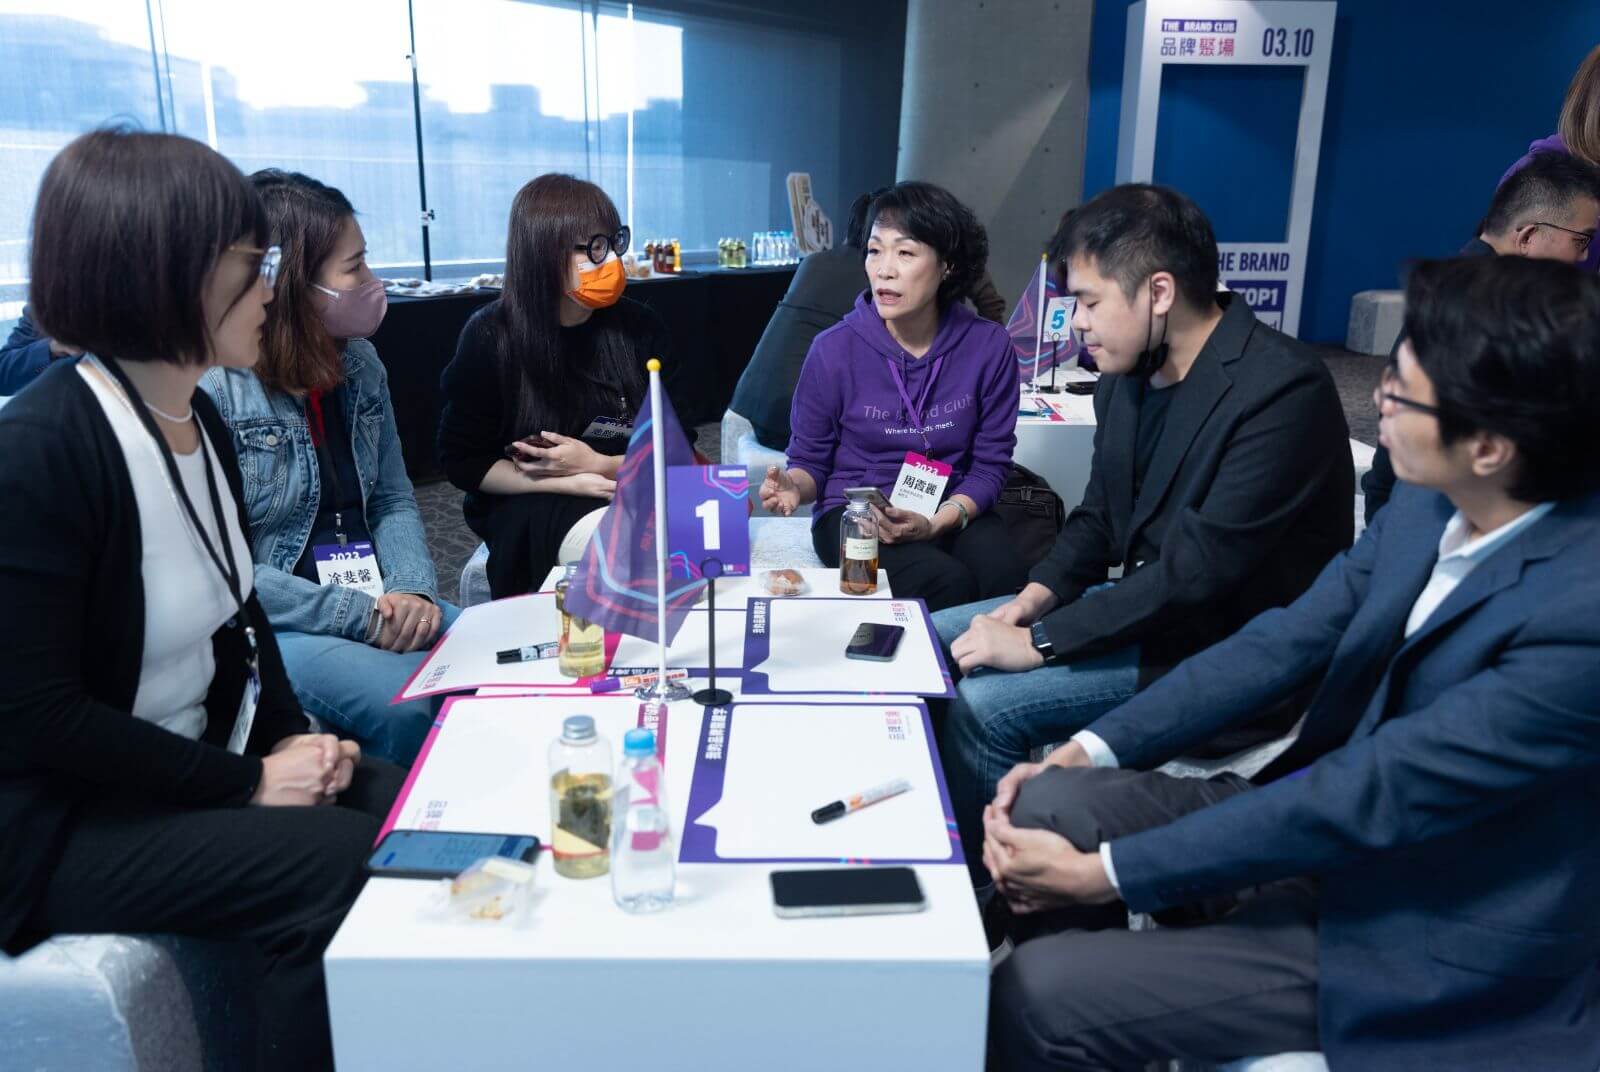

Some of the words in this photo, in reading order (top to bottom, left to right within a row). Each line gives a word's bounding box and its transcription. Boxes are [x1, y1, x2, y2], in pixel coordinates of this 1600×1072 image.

[1262, 28, 1314, 57] 03.10
[1218, 252, 1236, 271] HE
[1239, 252, 1290, 272] BRAND
[1051, 309, 1066, 330] 5
[863, 405, 890, 420] The
[695, 499, 720, 550] 1
